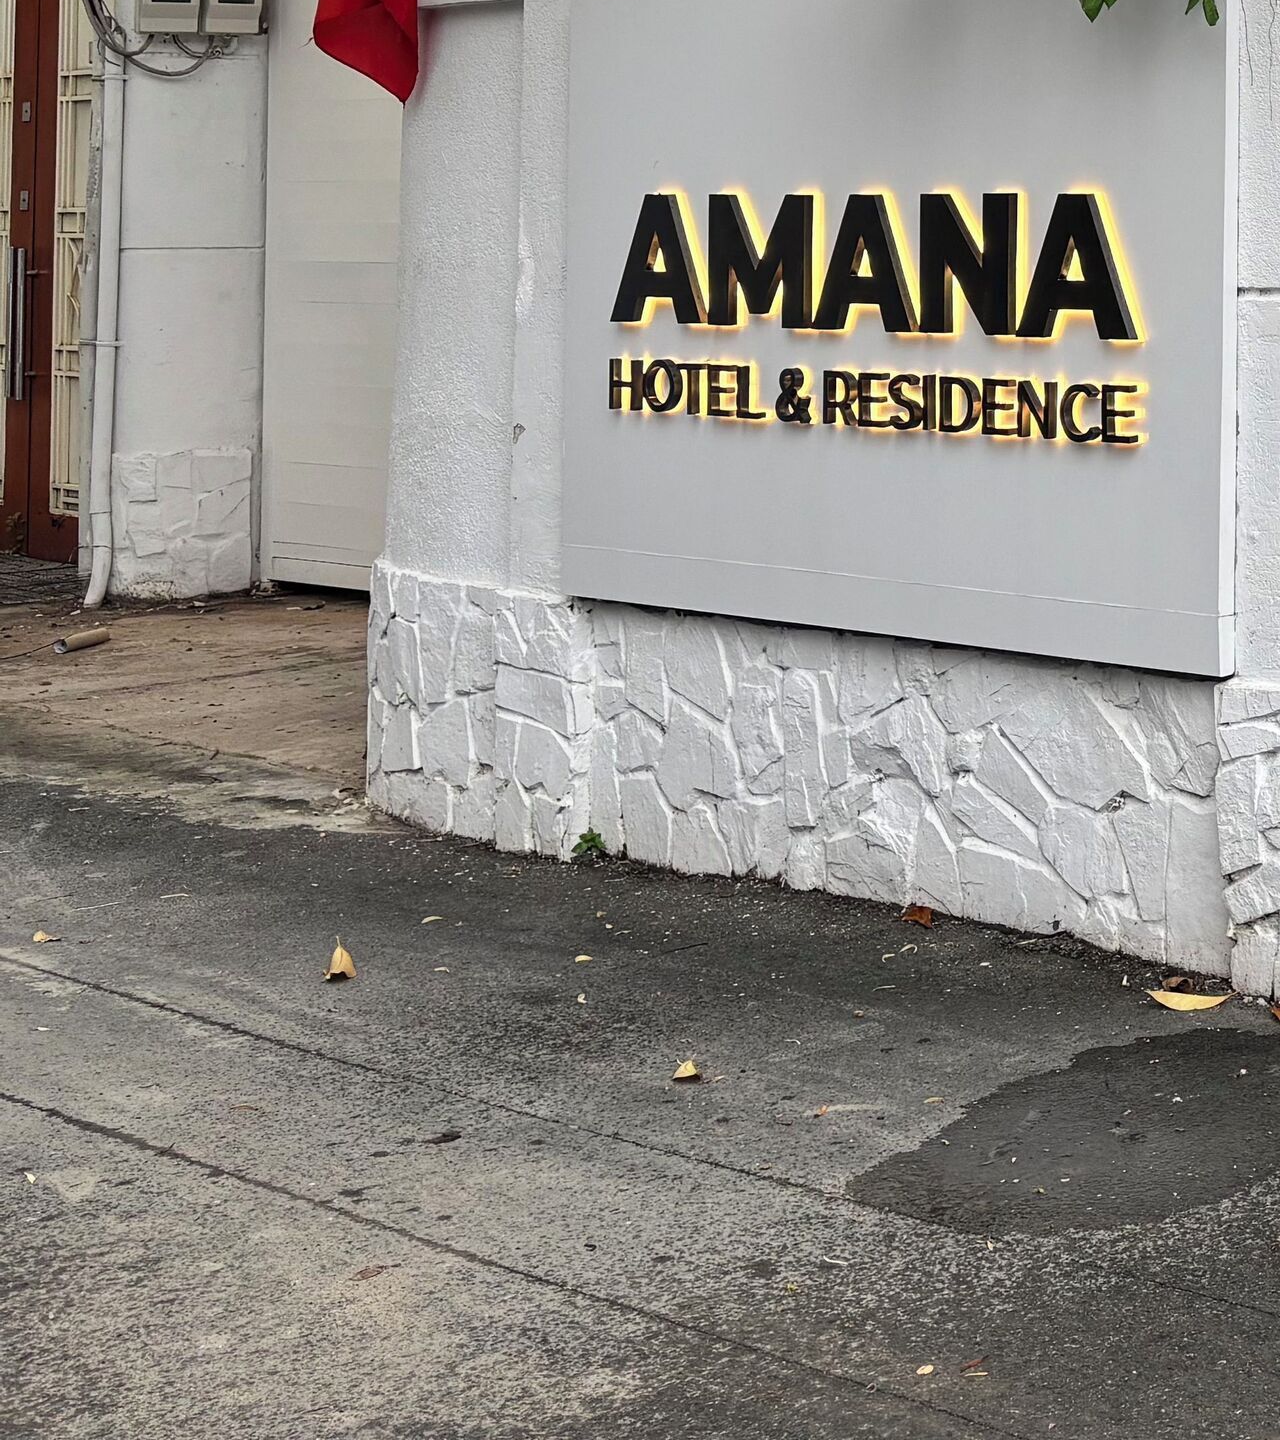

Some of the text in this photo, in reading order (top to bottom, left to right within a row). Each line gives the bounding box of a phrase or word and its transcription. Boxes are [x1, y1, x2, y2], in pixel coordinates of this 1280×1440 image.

[609, 192, 1139, 341] AMANA
[608, 357, 1140, 444] HOTEL & RESIDENCE
